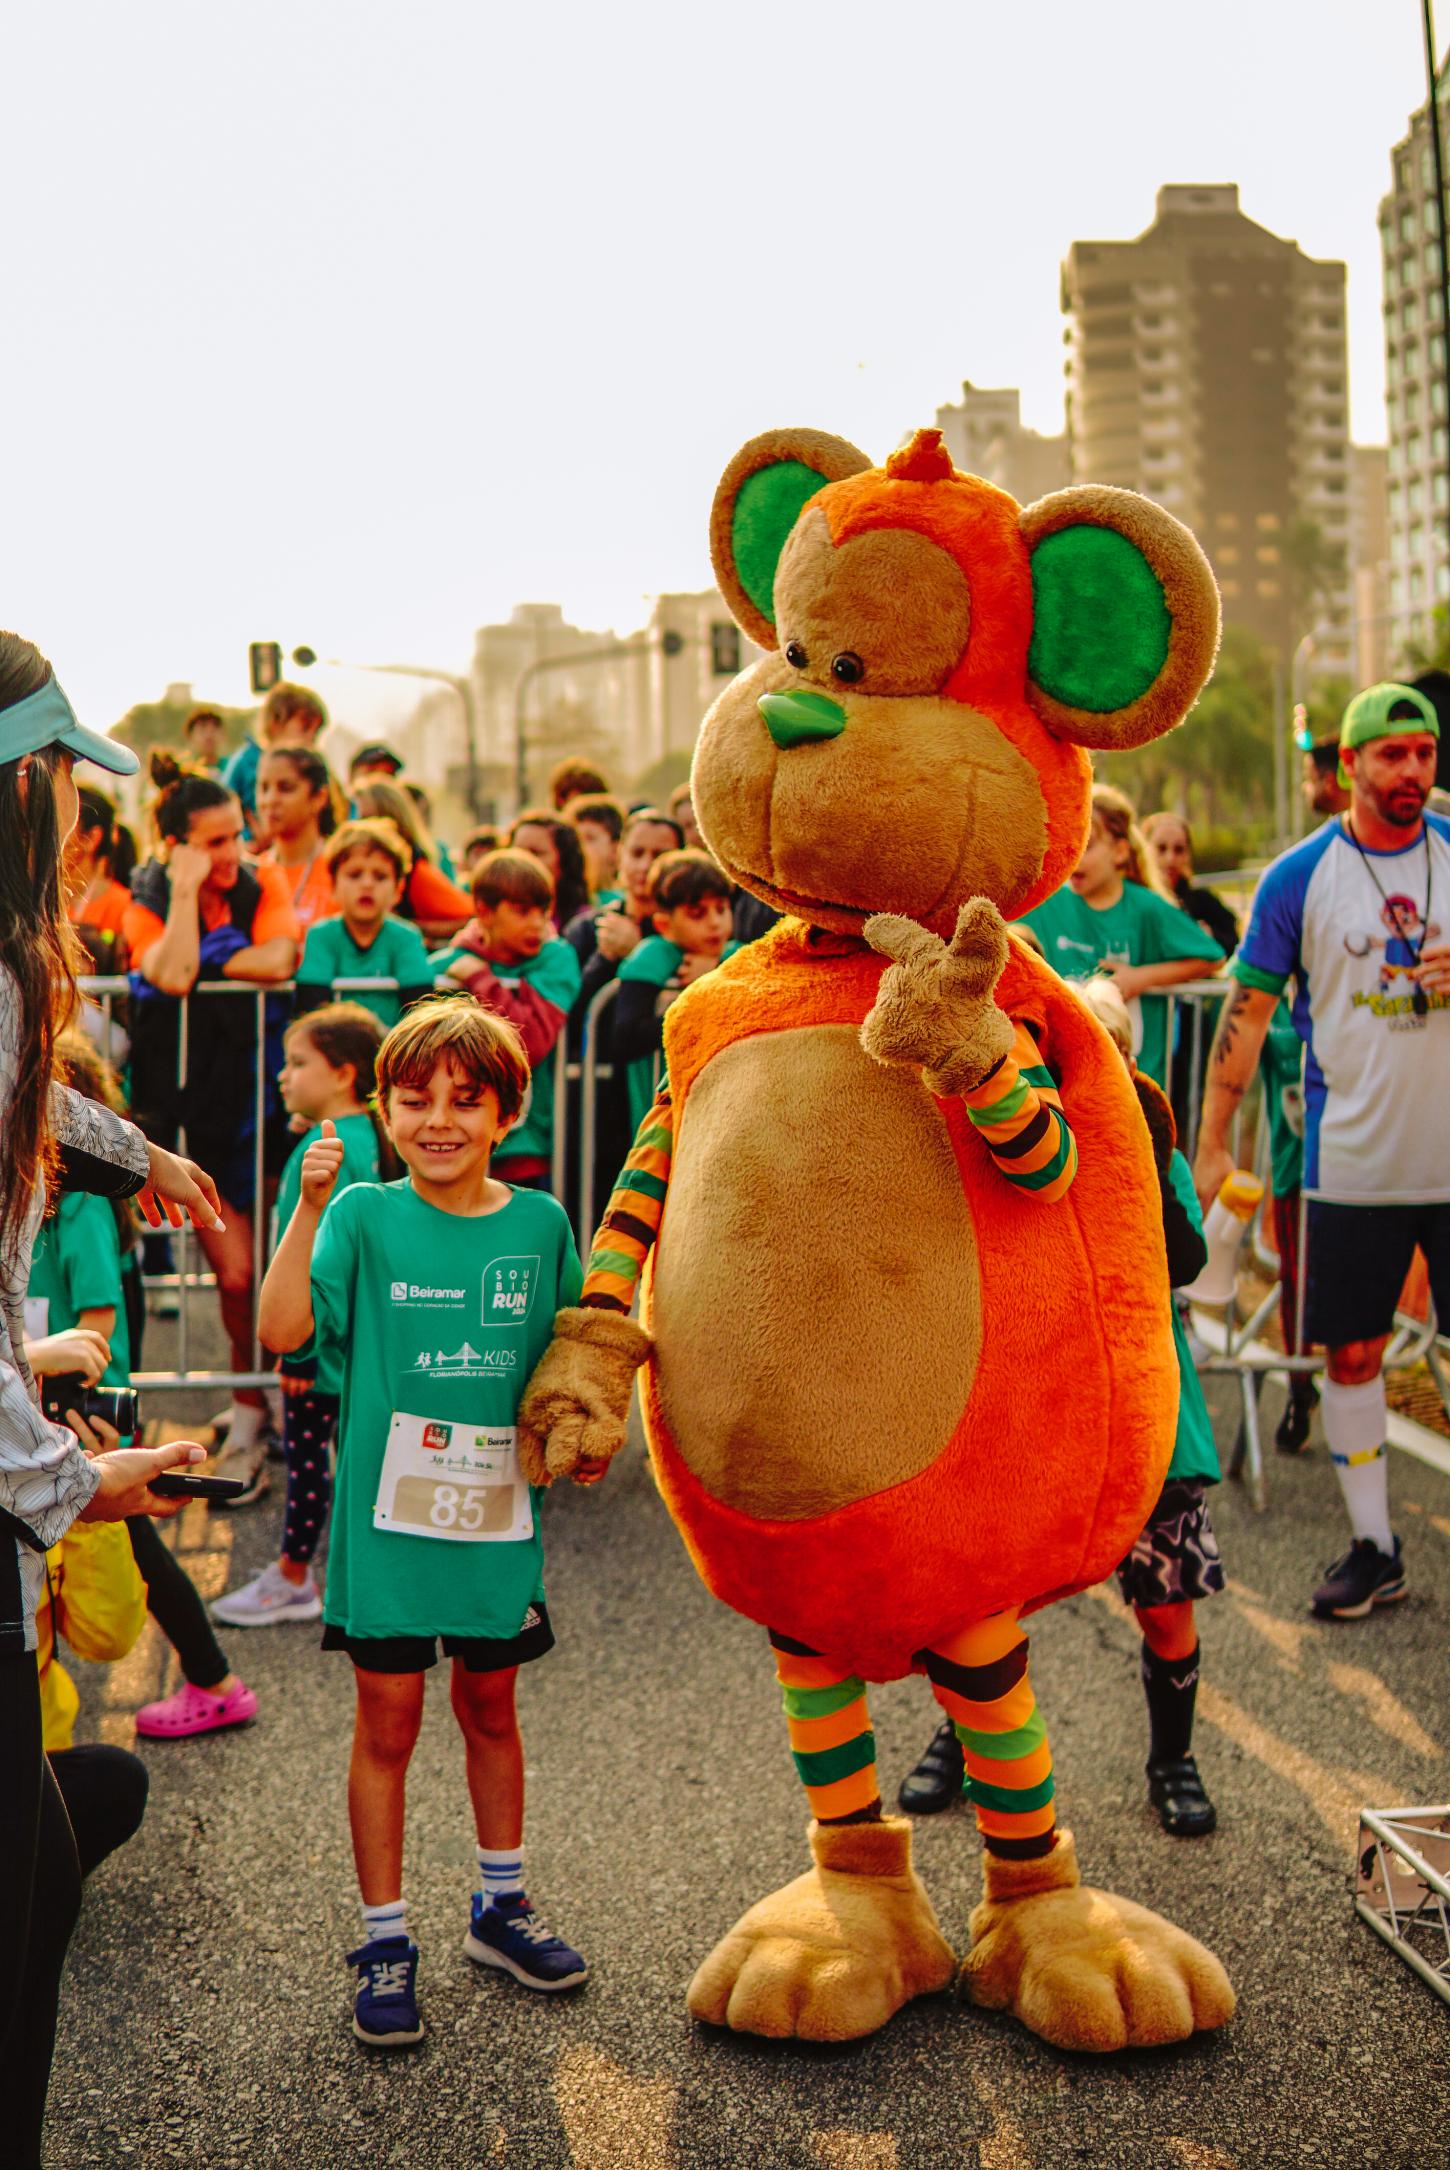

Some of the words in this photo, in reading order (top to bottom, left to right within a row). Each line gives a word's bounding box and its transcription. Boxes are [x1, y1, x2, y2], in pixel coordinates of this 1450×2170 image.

[409, 1285, 466, 1299] Beiramar
[492, 1292, 528, 1309] RUN
[483, 1350, 518, 1366] KIDS
[427, 1434, 447, 1445] RUN
[430, 1484, 488, 1531] 85
